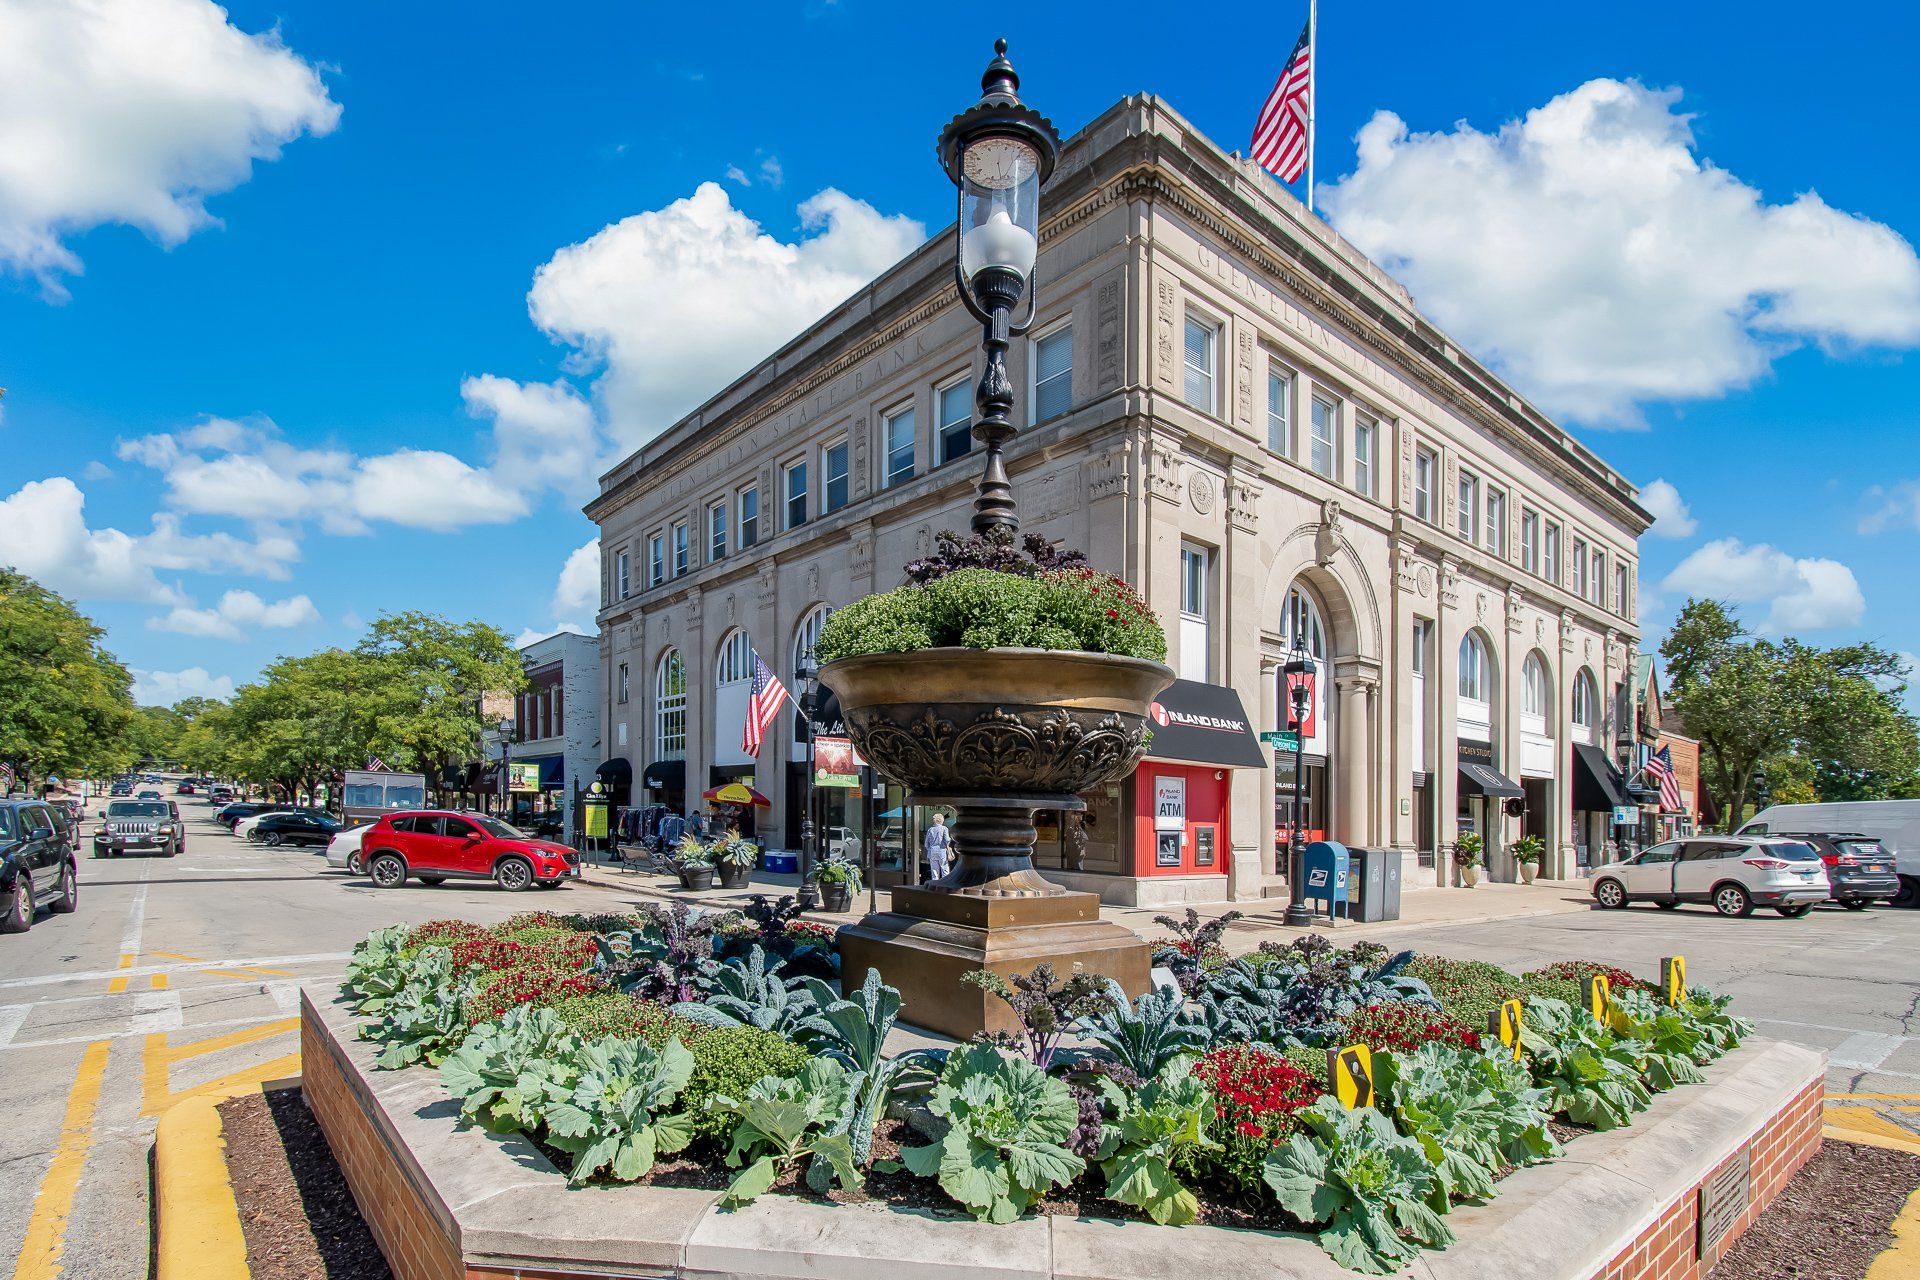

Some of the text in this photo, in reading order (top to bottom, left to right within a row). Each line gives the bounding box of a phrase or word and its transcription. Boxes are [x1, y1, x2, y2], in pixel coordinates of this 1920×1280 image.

[1197, 244, 1435, 418] GLEN ELLYN STATE BANK
[706, 434, 758, 478] ELLYN
[773, 386, 838, 439] STATE
[855, 333, 926, 390] BANK
[815, 721, 828, 735] The
[1168, 710, 1211, 727] INLAND
[1211, 717, 1244, 731] BANK
[1159, 802, 1181, 816] ATM
